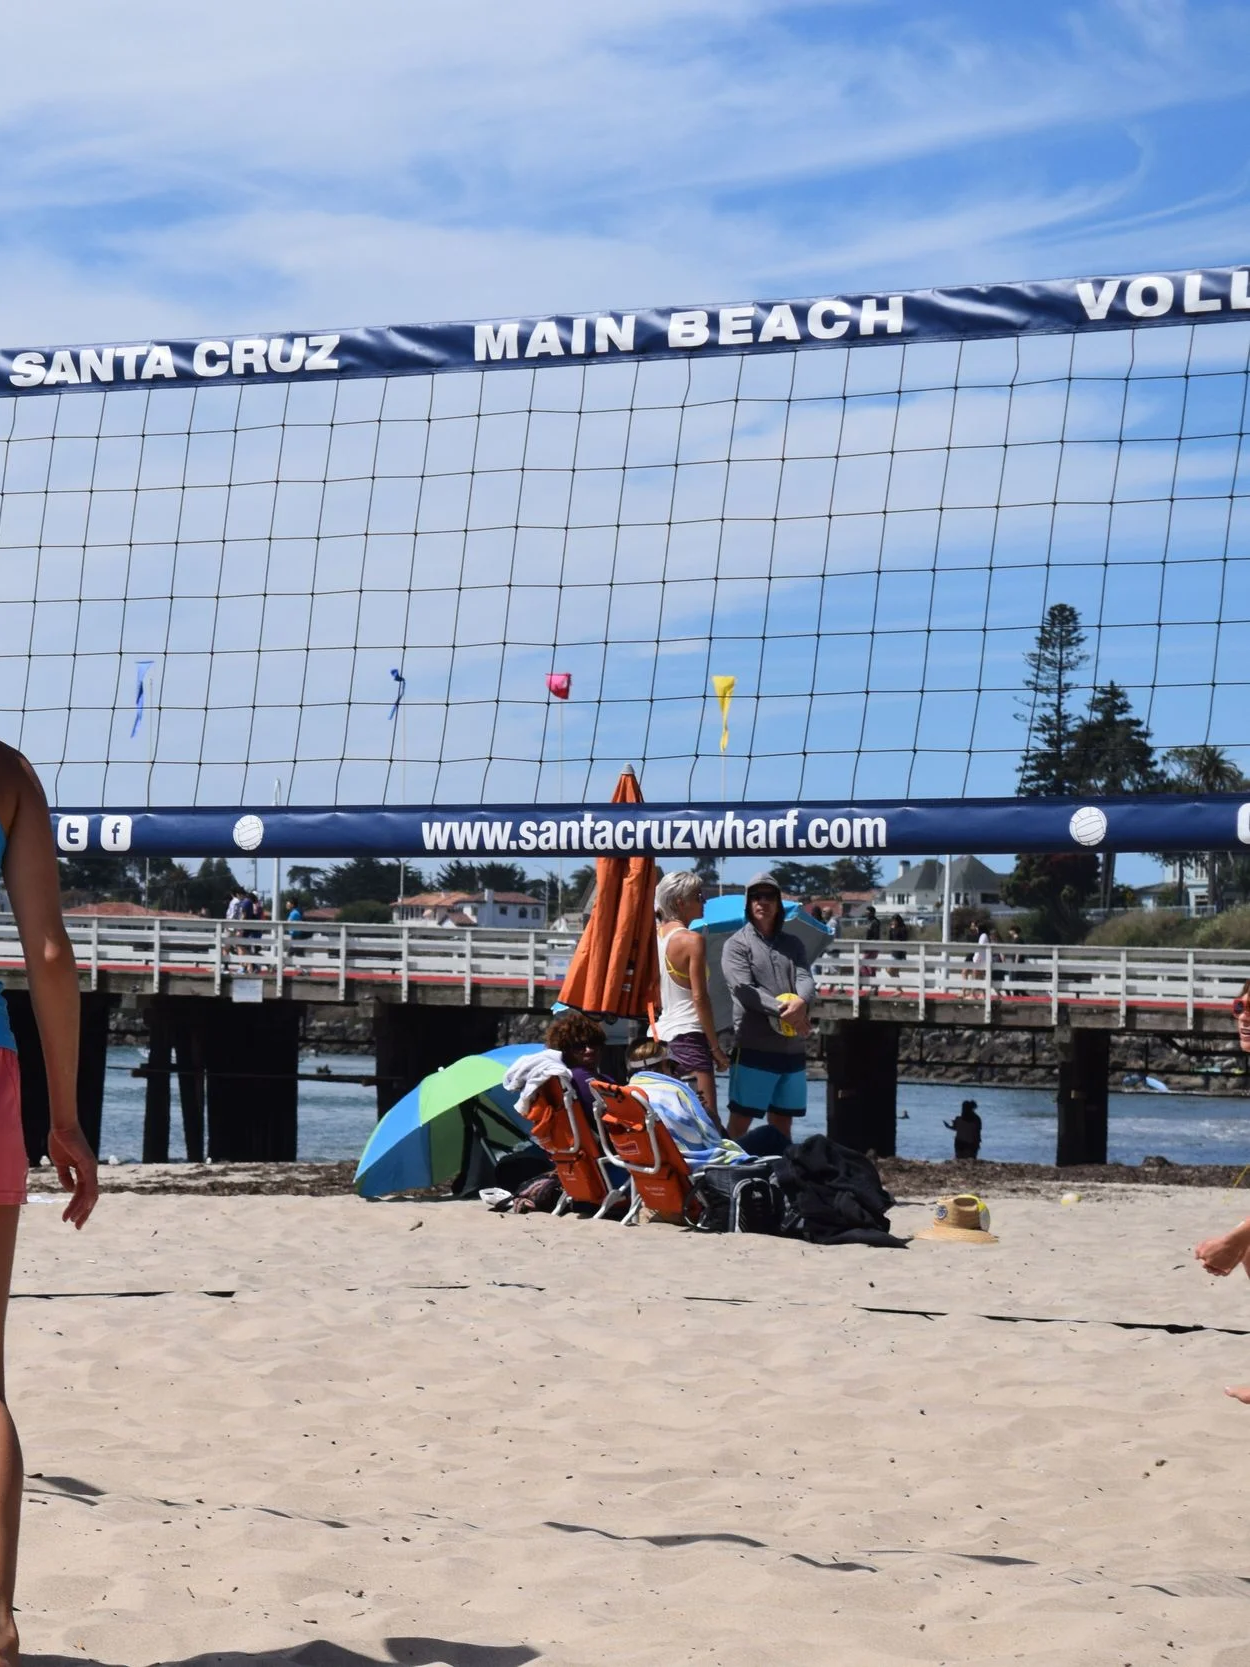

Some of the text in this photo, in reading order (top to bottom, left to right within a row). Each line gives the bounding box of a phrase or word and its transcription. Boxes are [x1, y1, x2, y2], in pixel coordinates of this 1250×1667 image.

[9, 344, 179, 388] SANTA
[192, 334, 340, 377] CRUZ
[473, 315, 636, 362] MAIN
[666, 295, 905, 352] BEACH
[421, 809, 887, 851] www.santacruzwharf.com
